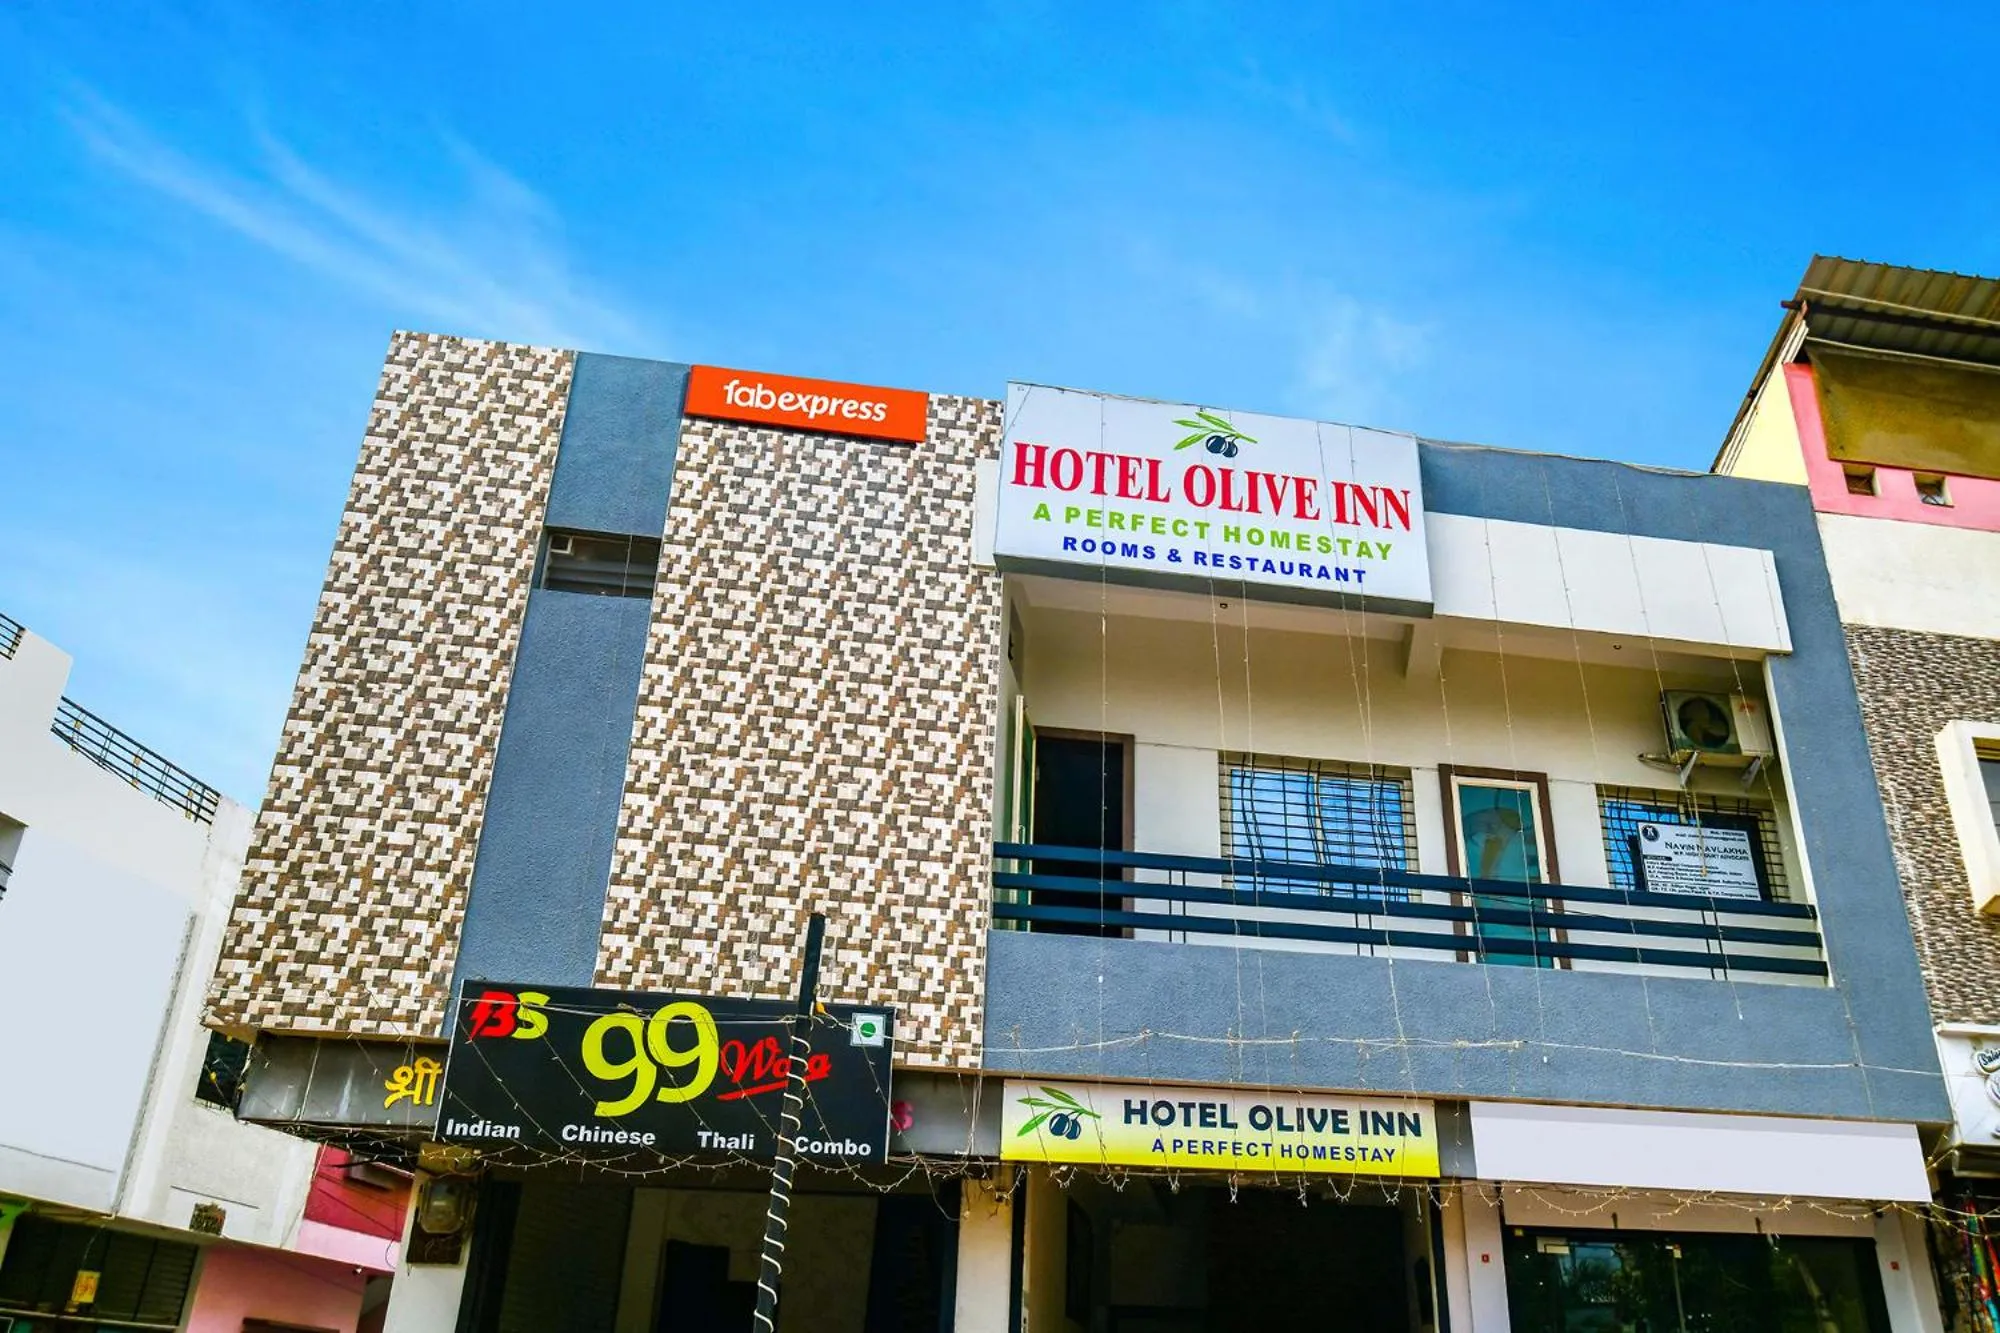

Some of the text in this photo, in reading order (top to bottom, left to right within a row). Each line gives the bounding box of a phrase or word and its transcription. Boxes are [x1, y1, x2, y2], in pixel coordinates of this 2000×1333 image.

[1012, 442, 1411, 531] HOTEL OLIVE INN
[1033, 502, 1392, 560] A PERFECT HOMESTAY
[1062, 536, 1367, 583] ROOMS & RESTAURANT
[384, 1057, 443, 1109] श्री
[582, 1001, 719, 1117] 99
[446, 1118, 872, 1156] Indian Chinese Thali Combo
[1123, 1099, 1422, 1138] HOTEL OLIVE INN
[1151, 1138, 1396, 1163] A PERFECT HOMESTAY
